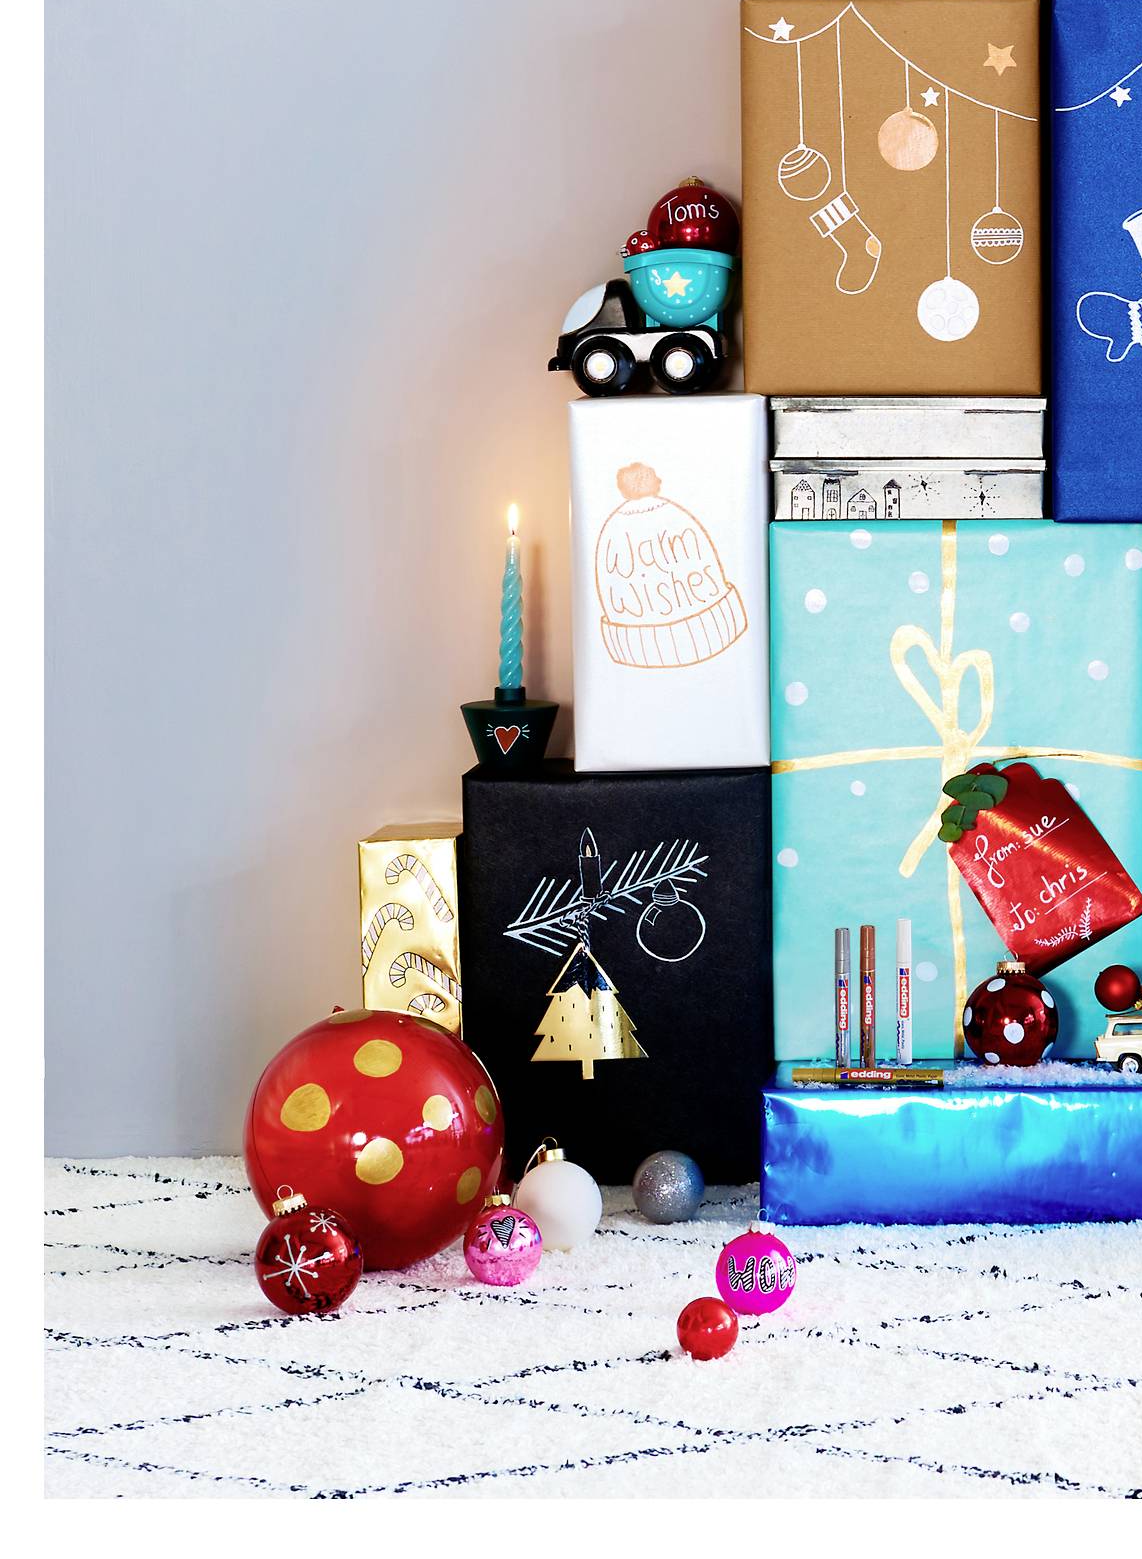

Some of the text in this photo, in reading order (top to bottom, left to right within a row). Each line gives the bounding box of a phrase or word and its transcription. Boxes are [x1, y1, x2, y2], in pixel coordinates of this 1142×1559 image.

[659, 194, 720, 225] Tom's
[1022, 814, 1057, 846] sue
[1039, 863, 1088, 905] chris
[839, 989, 849, 1030] edding
[864, 985, 874, 1026] edding
[900, 977, 909, 1017] edding
[850, 1069, 892, 1080] edding
